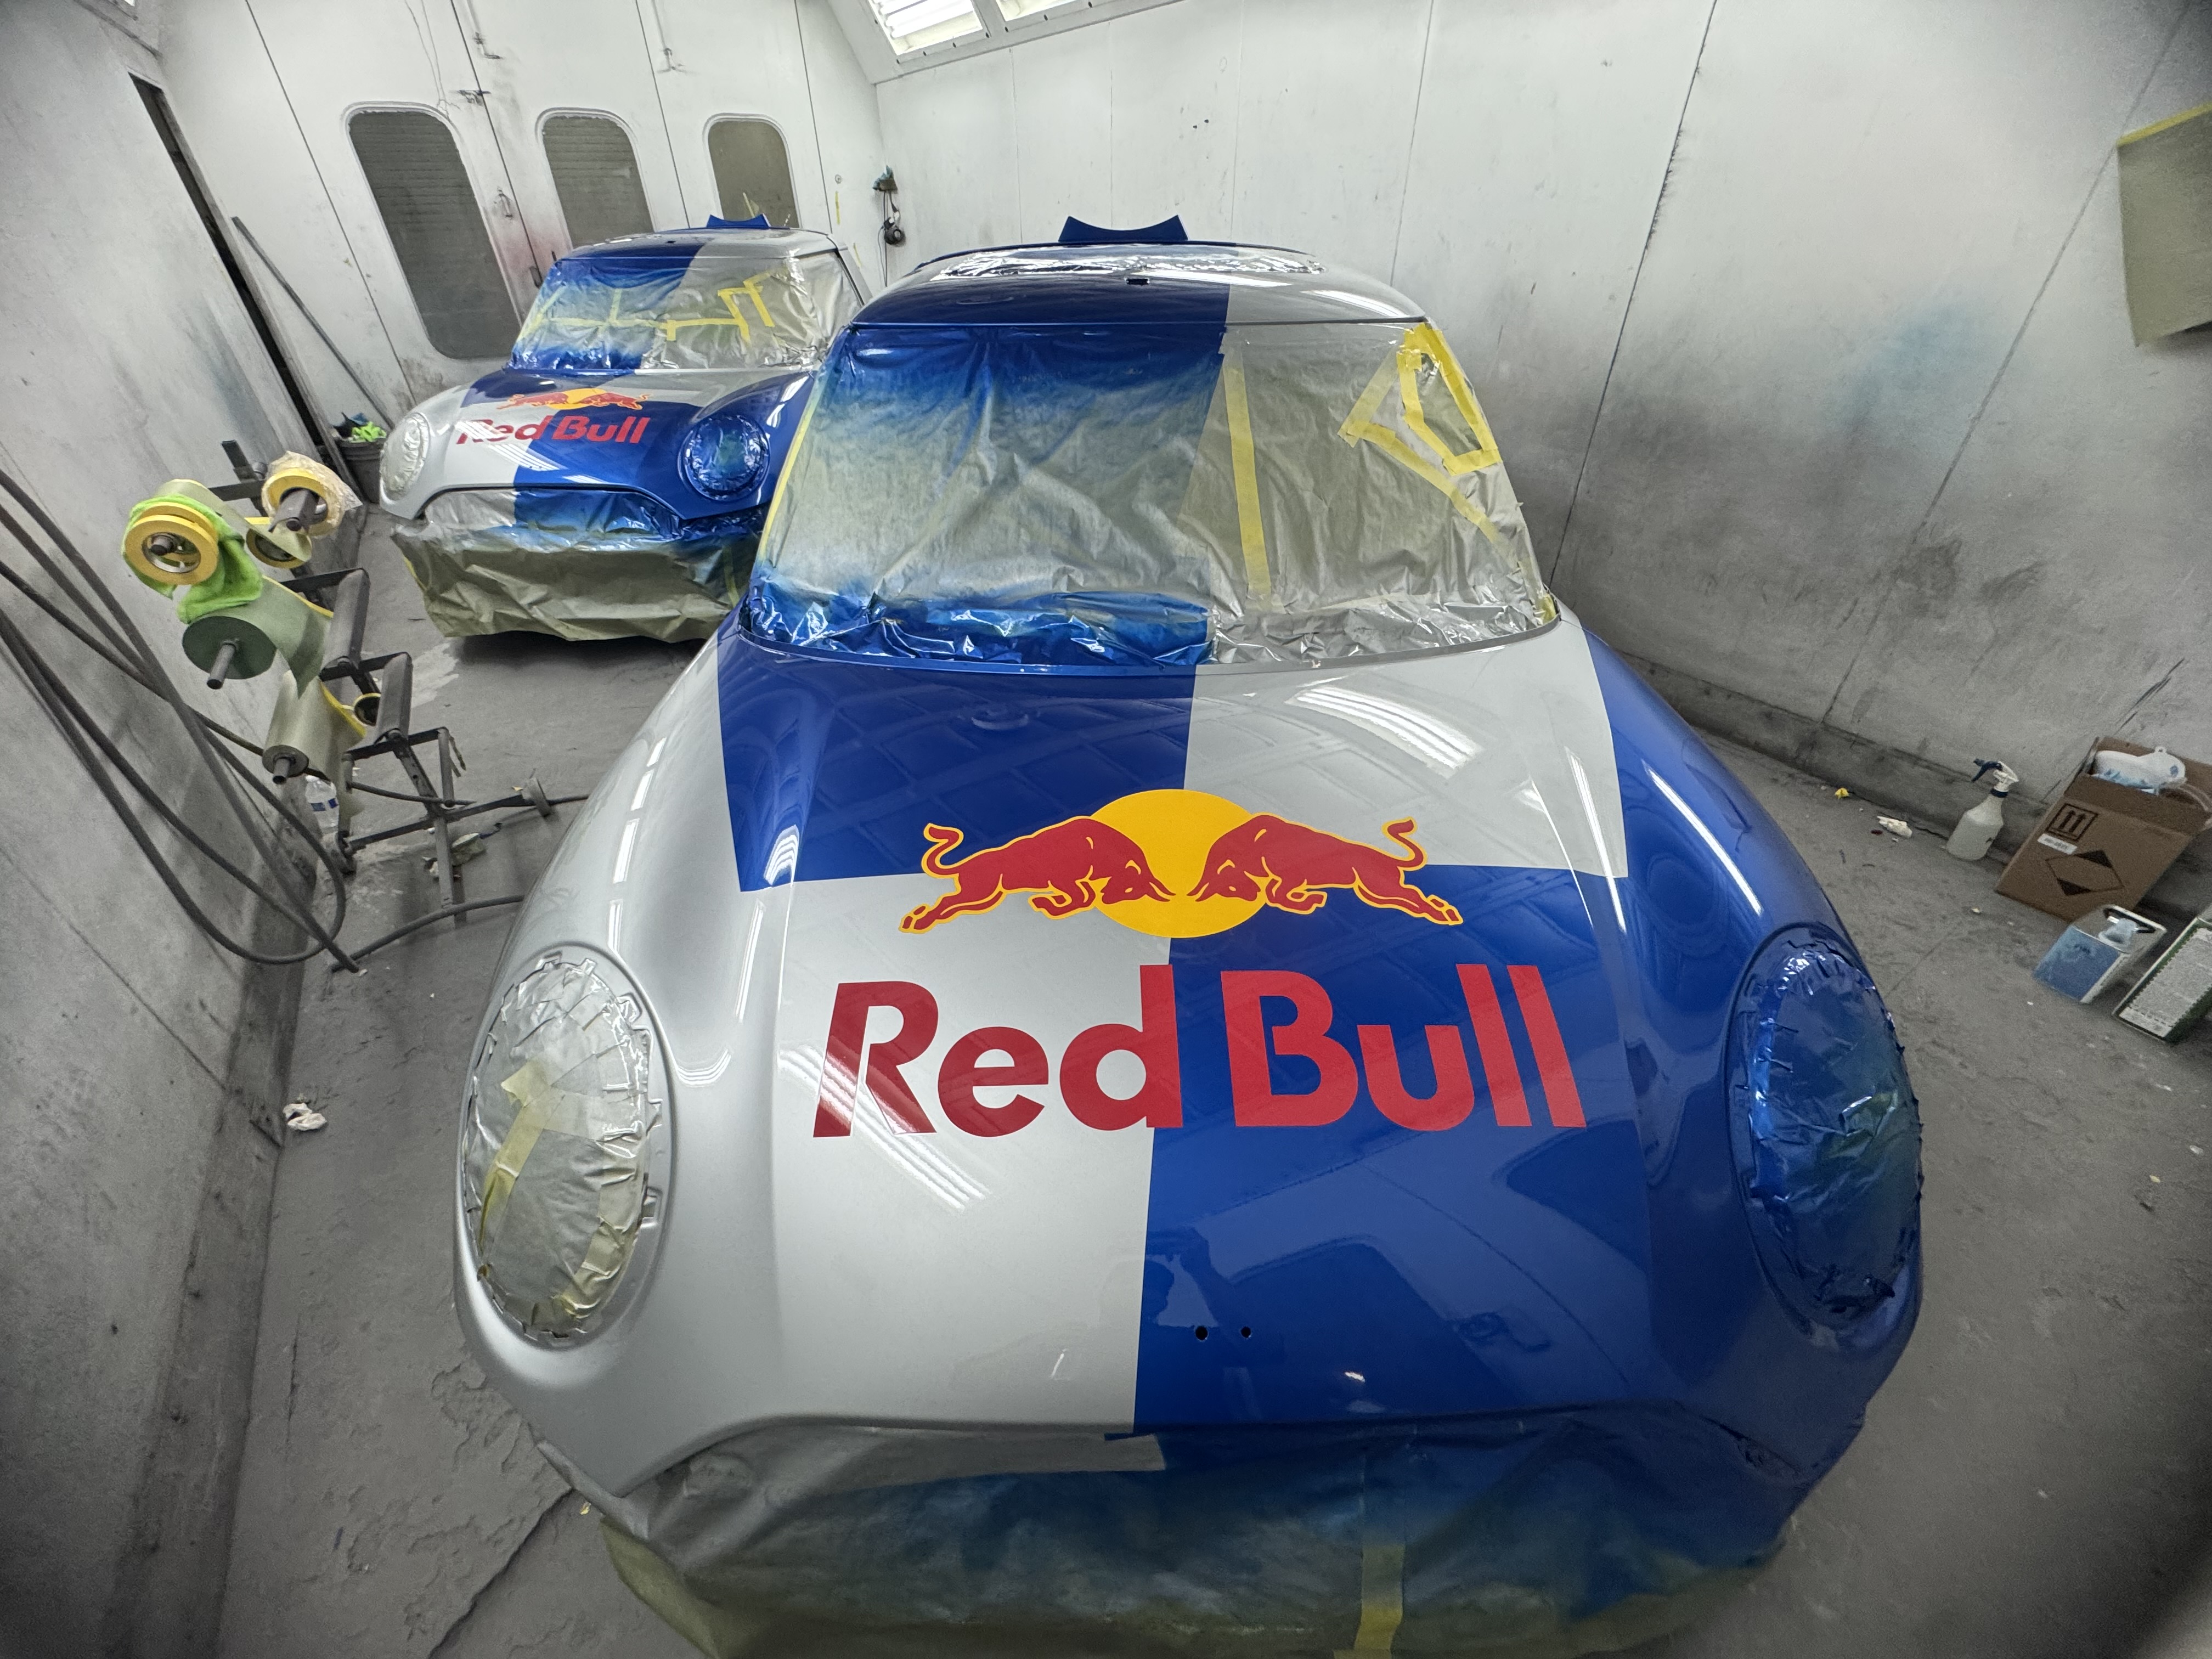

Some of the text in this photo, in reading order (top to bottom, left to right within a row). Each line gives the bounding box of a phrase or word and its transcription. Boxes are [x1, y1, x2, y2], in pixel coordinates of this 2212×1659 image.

[552, 415, 650, 443] Bull
[813, 963, 1587, 1138] Red Bull
